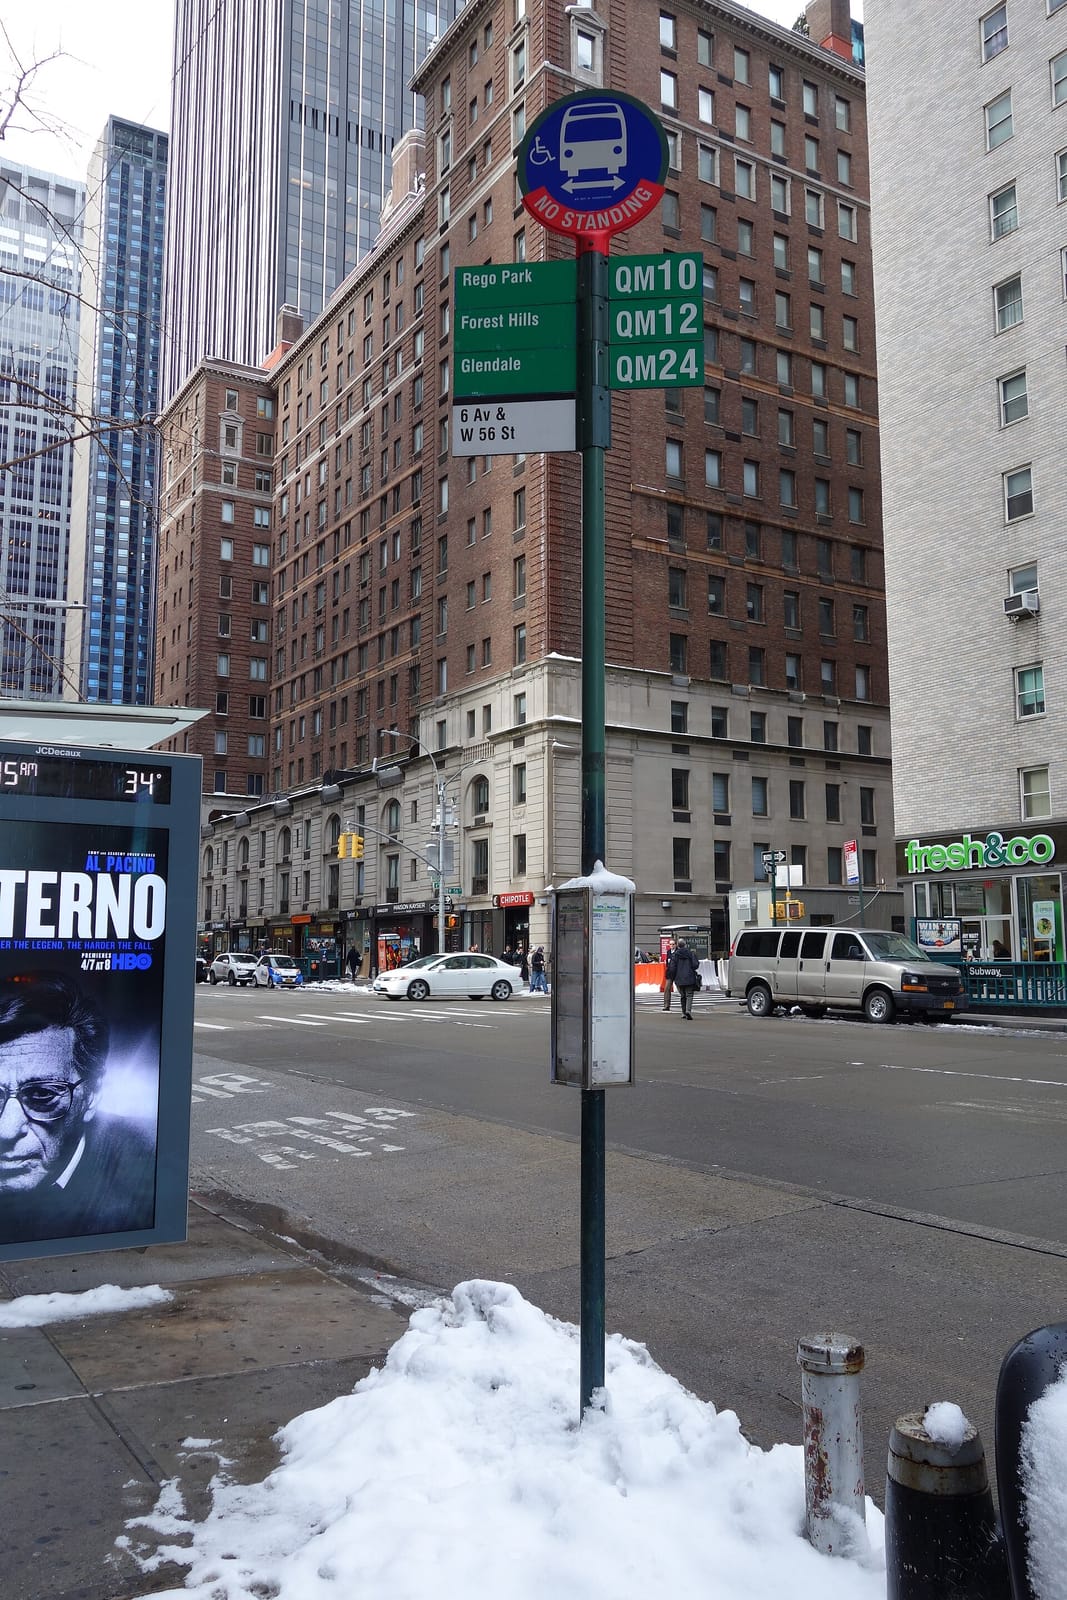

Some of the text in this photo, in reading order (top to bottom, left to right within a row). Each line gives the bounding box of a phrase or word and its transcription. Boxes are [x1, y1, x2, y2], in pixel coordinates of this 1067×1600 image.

[534, 187, 653, 230] NO STANDING
[463, 269, 533, 288] Rego Park
[615, 259, 697, 295] QM10
[461, 312, 539, 331] Forest Hills
[616, 303, 698, 339] QM12
[461, 357, 521, 373] Glendale
[616, 348, 698, 384] QM24
[460, 407, 506, 423] 6 Av &
[460, 426, 515, 442] W 56 St
[35, 747, 81, 758] JCDecaux
[905, 832, 1055, 873] fresh&co
[86, 855, 155, 873] AL PACINO
[500, 894, 529, 904] CHIPOTLE
[14, 941, 29, 949] THE
[32, 941, 64, 950] LEGEND,
[68, 941, 82, 950] THE
[84, 942, 115, 950] HARDER
[118, 942, 133, 950] THE
[112, 953, 152, 971] HBO
[969, 967, 1001, 977] Subway
